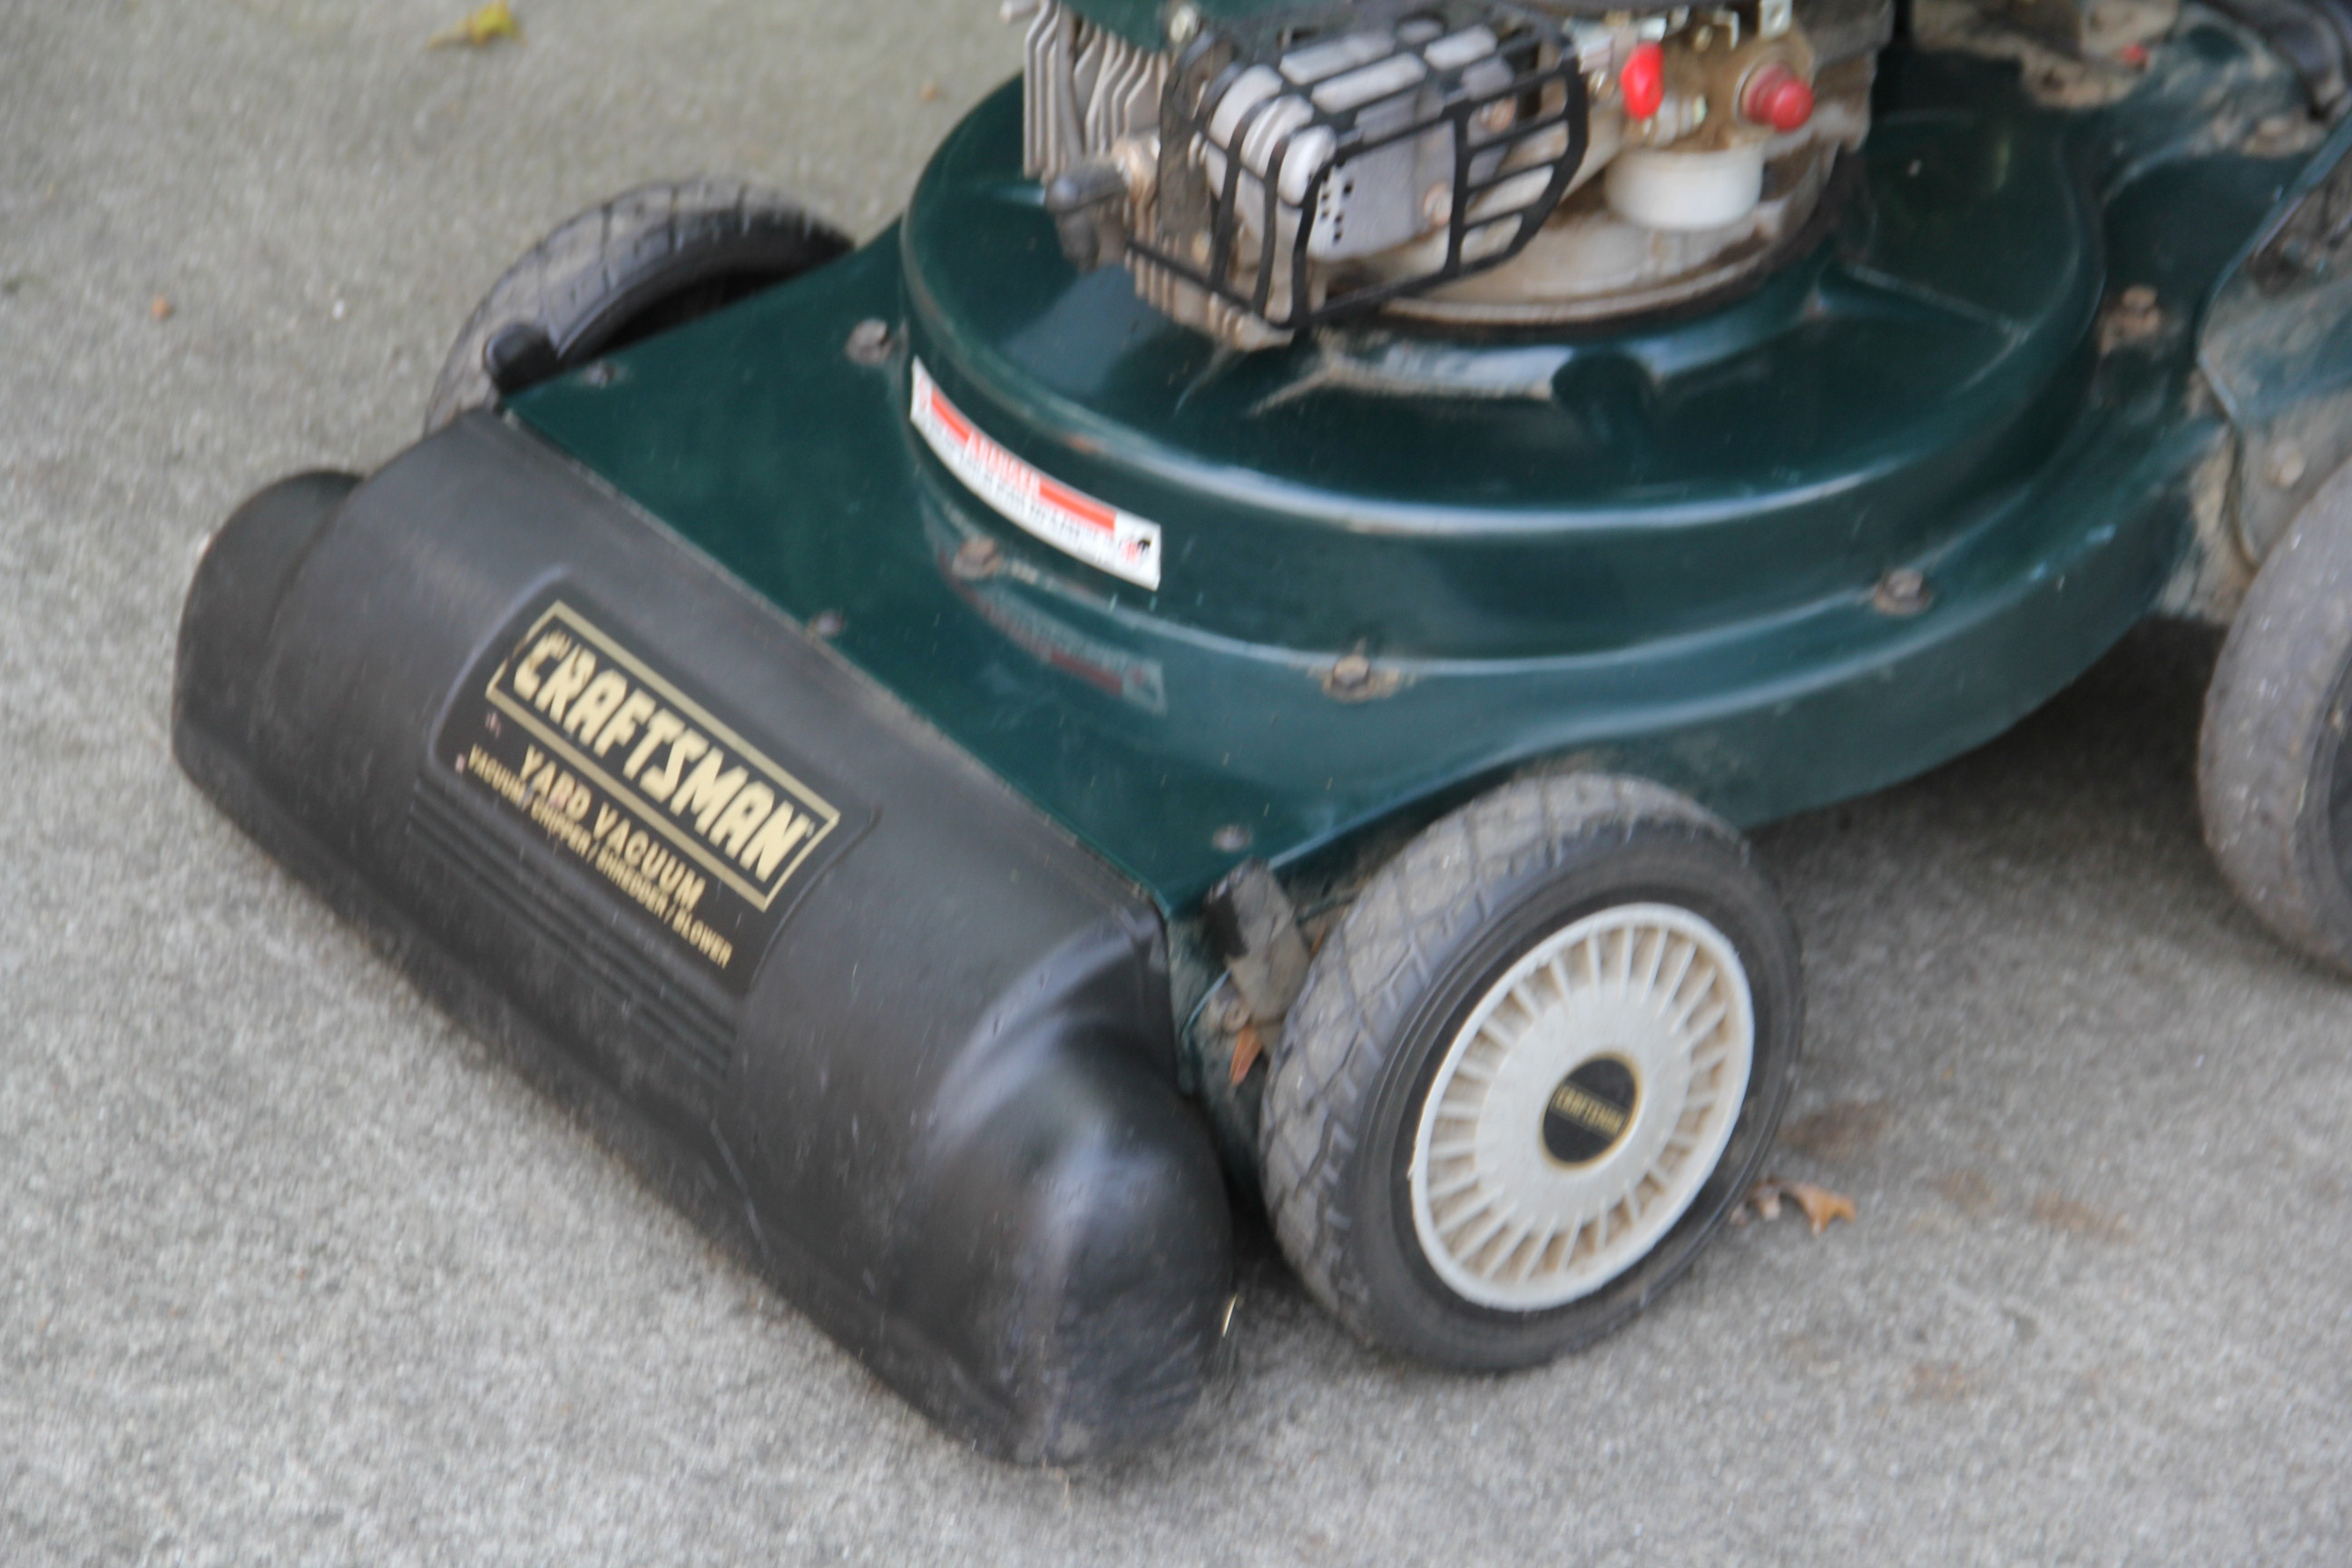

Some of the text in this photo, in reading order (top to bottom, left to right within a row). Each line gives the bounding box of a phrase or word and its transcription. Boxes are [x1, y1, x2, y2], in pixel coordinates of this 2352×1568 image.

[514, 629, 810, 883] CRAFTSMAN
[520, 744, 706, 911] YARD VACUUM
